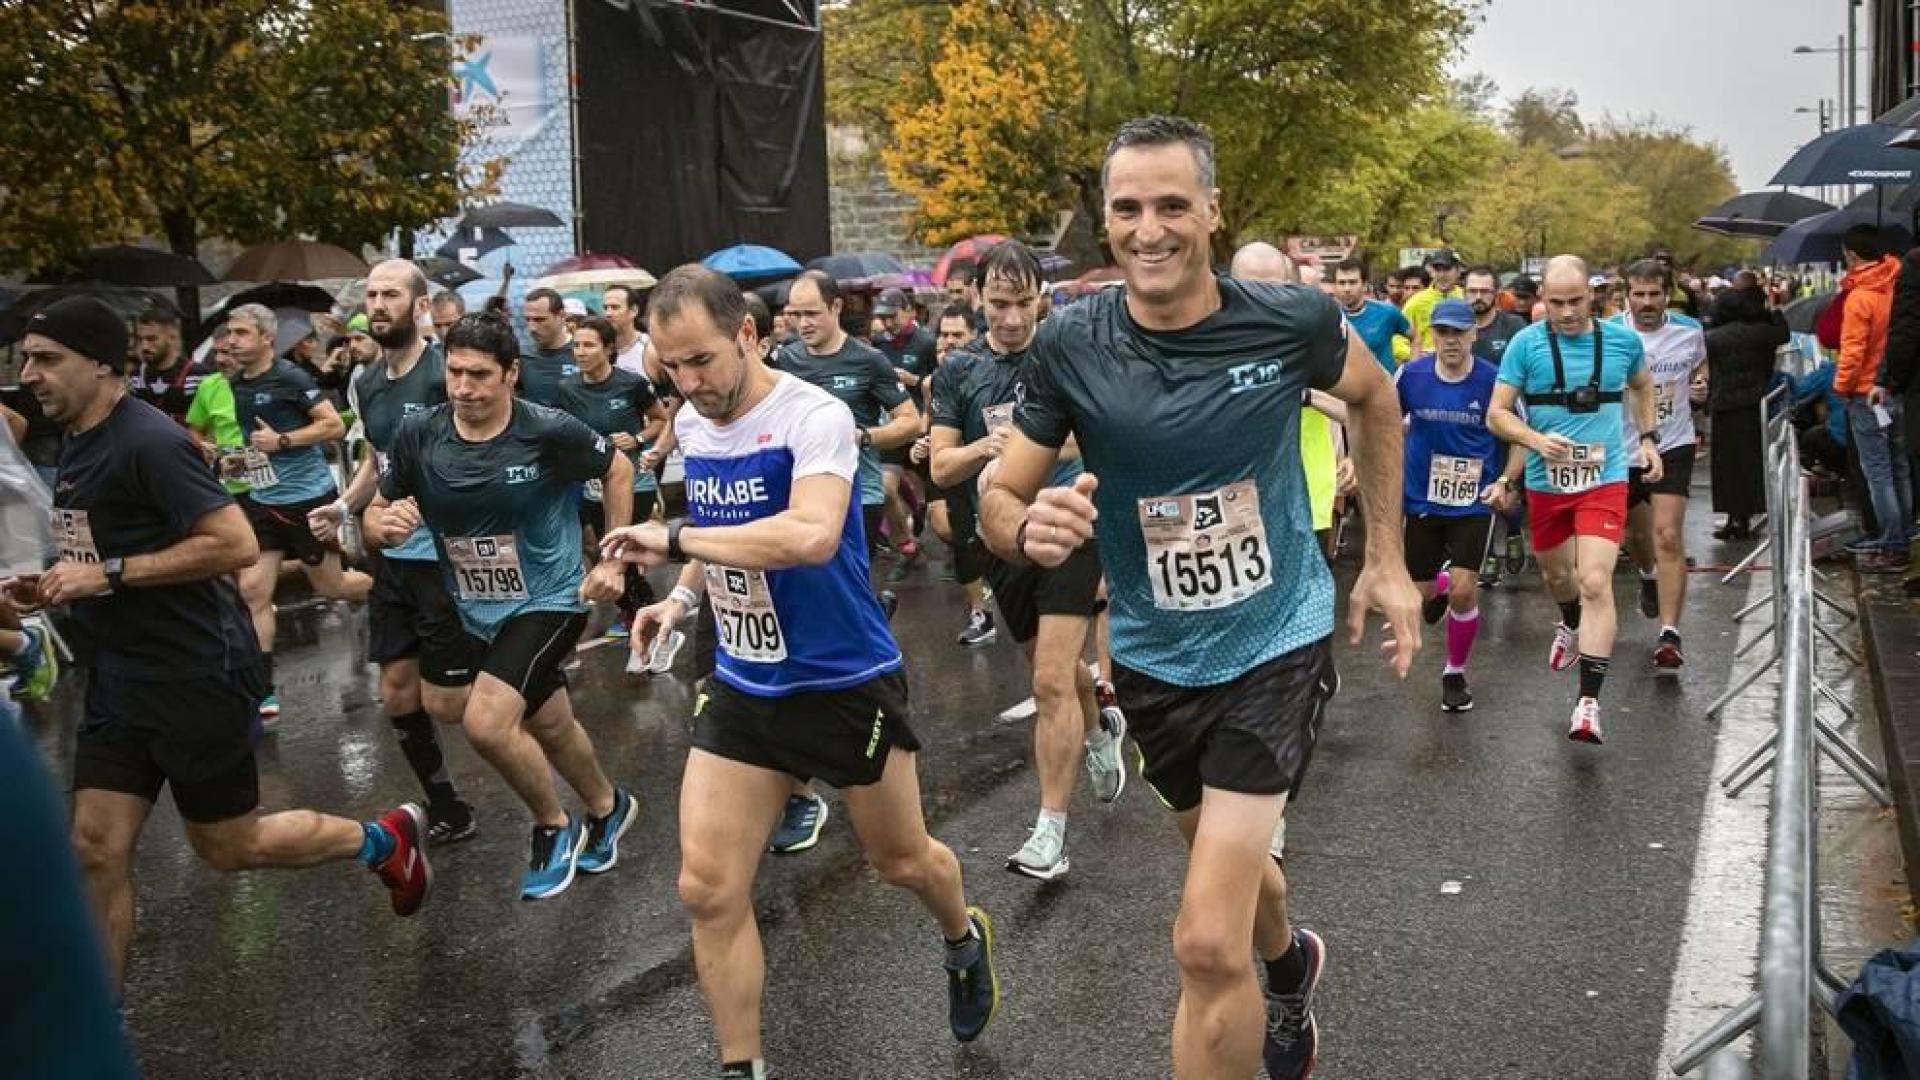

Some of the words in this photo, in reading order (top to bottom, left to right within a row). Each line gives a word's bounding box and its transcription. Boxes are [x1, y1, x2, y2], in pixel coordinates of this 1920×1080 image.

[1432, 478, 1477, 500] 16169
[460, 567, 523, 592] 15798
[1156, 534, 1266, 598] 15513
[714, 602, 781, 651] 5709
[866, 708, 885, 759] SCOTT
